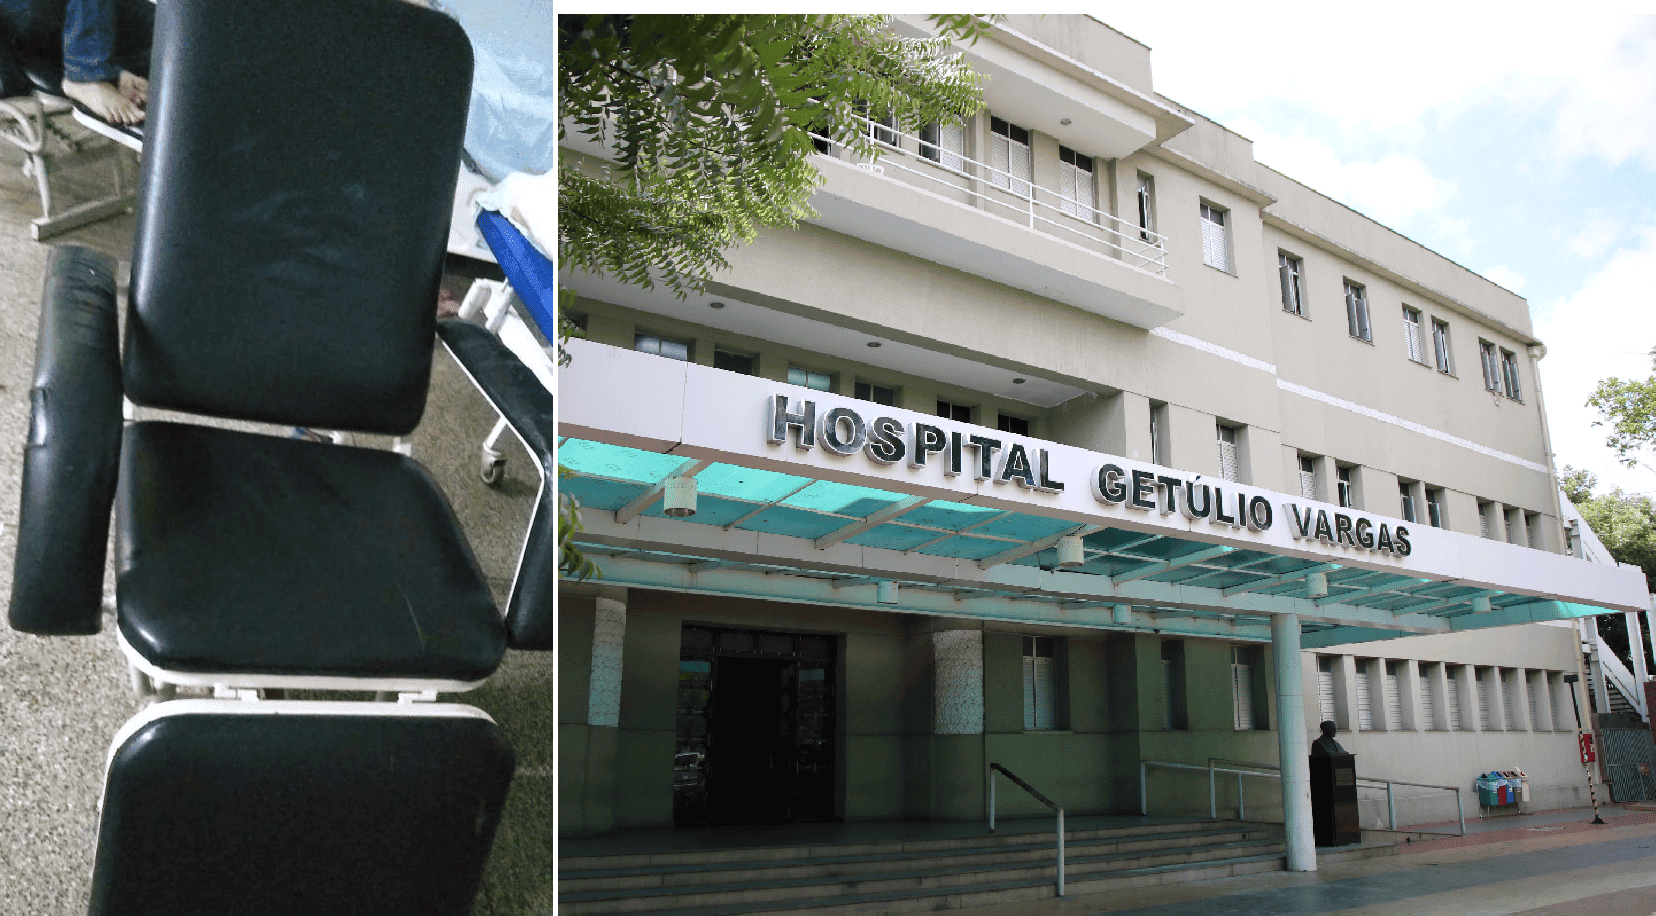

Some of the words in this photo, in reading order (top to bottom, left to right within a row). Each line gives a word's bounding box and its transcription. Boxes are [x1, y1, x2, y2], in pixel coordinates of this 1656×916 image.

[767, 394, 1065, 494] HOSPITAL
[1090, 463, 1273, 532] GETÚLIO
[1282, 503, 1412, 558] VARGAS
